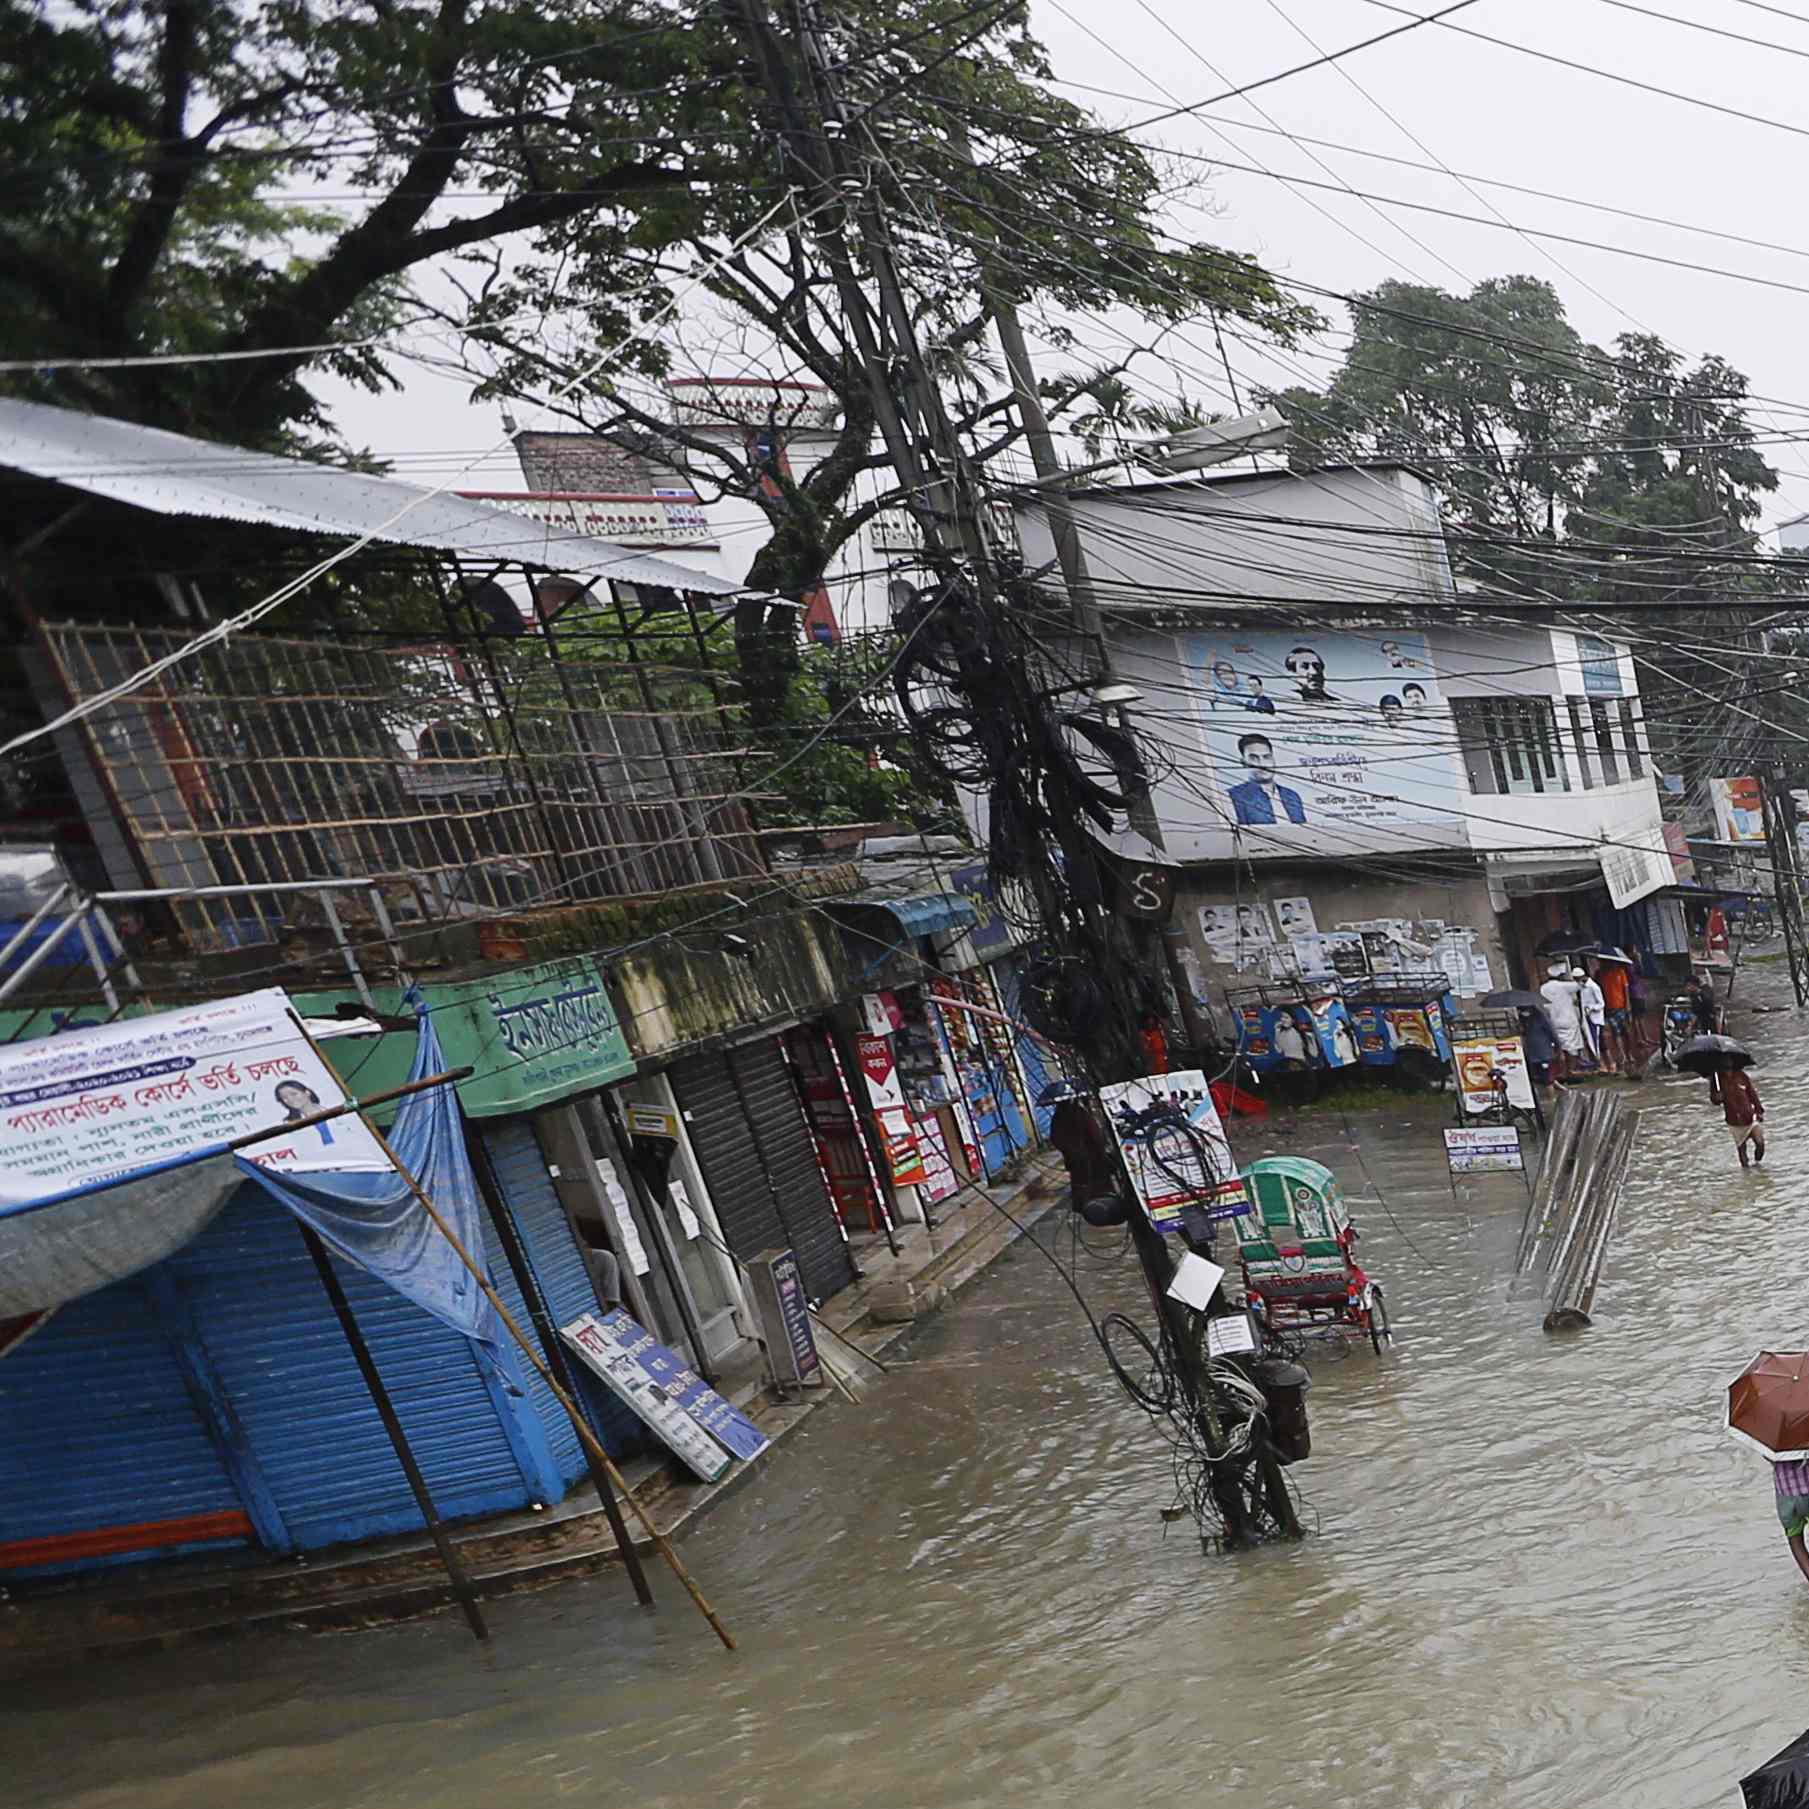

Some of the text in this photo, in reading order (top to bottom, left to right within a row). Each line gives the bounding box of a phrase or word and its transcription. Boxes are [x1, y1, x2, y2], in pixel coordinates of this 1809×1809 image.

[7, 1055, 306, 1134] প্যারামেডিক কোর্সে ভর্তি চলছে
